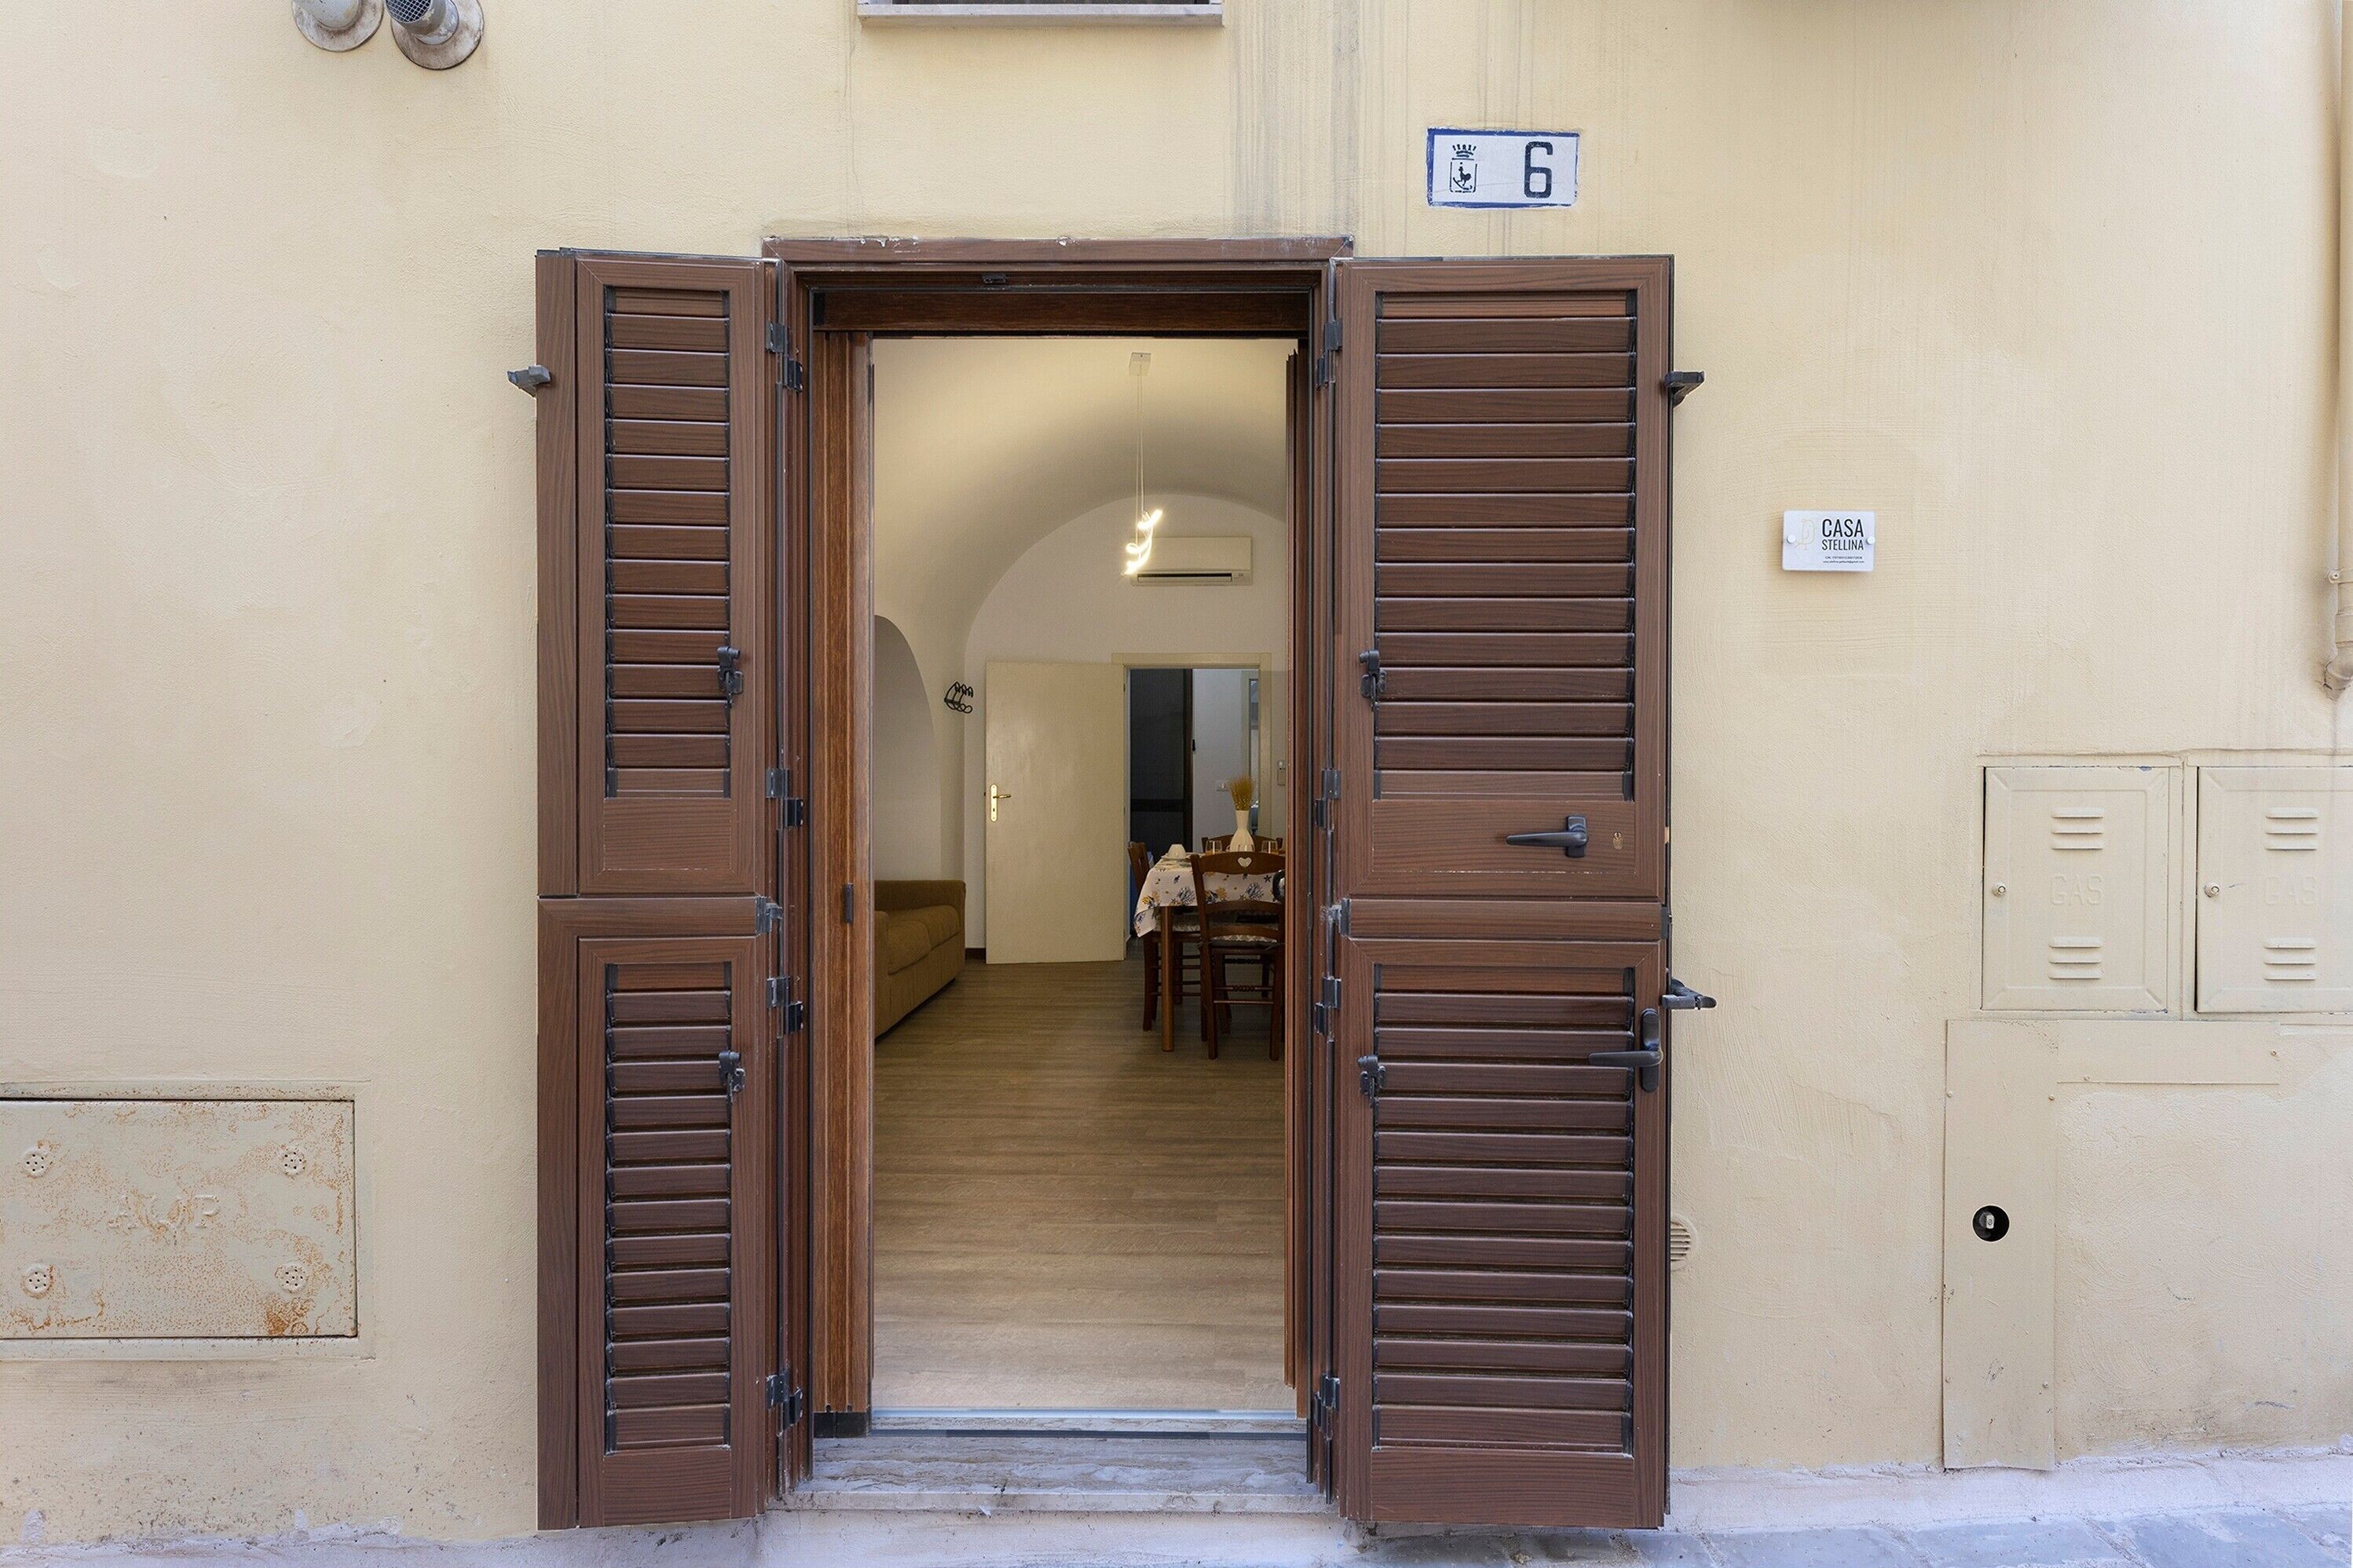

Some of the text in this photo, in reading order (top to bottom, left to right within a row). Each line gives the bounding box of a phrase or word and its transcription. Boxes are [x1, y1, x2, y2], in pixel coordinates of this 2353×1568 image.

[1524, 141, 1553, 199] 6
[1822, 518, 1864, 538] CASA
[1821, 539, 1864, 551] STELLINA
[2049, 873, 2104, 906] GAS
